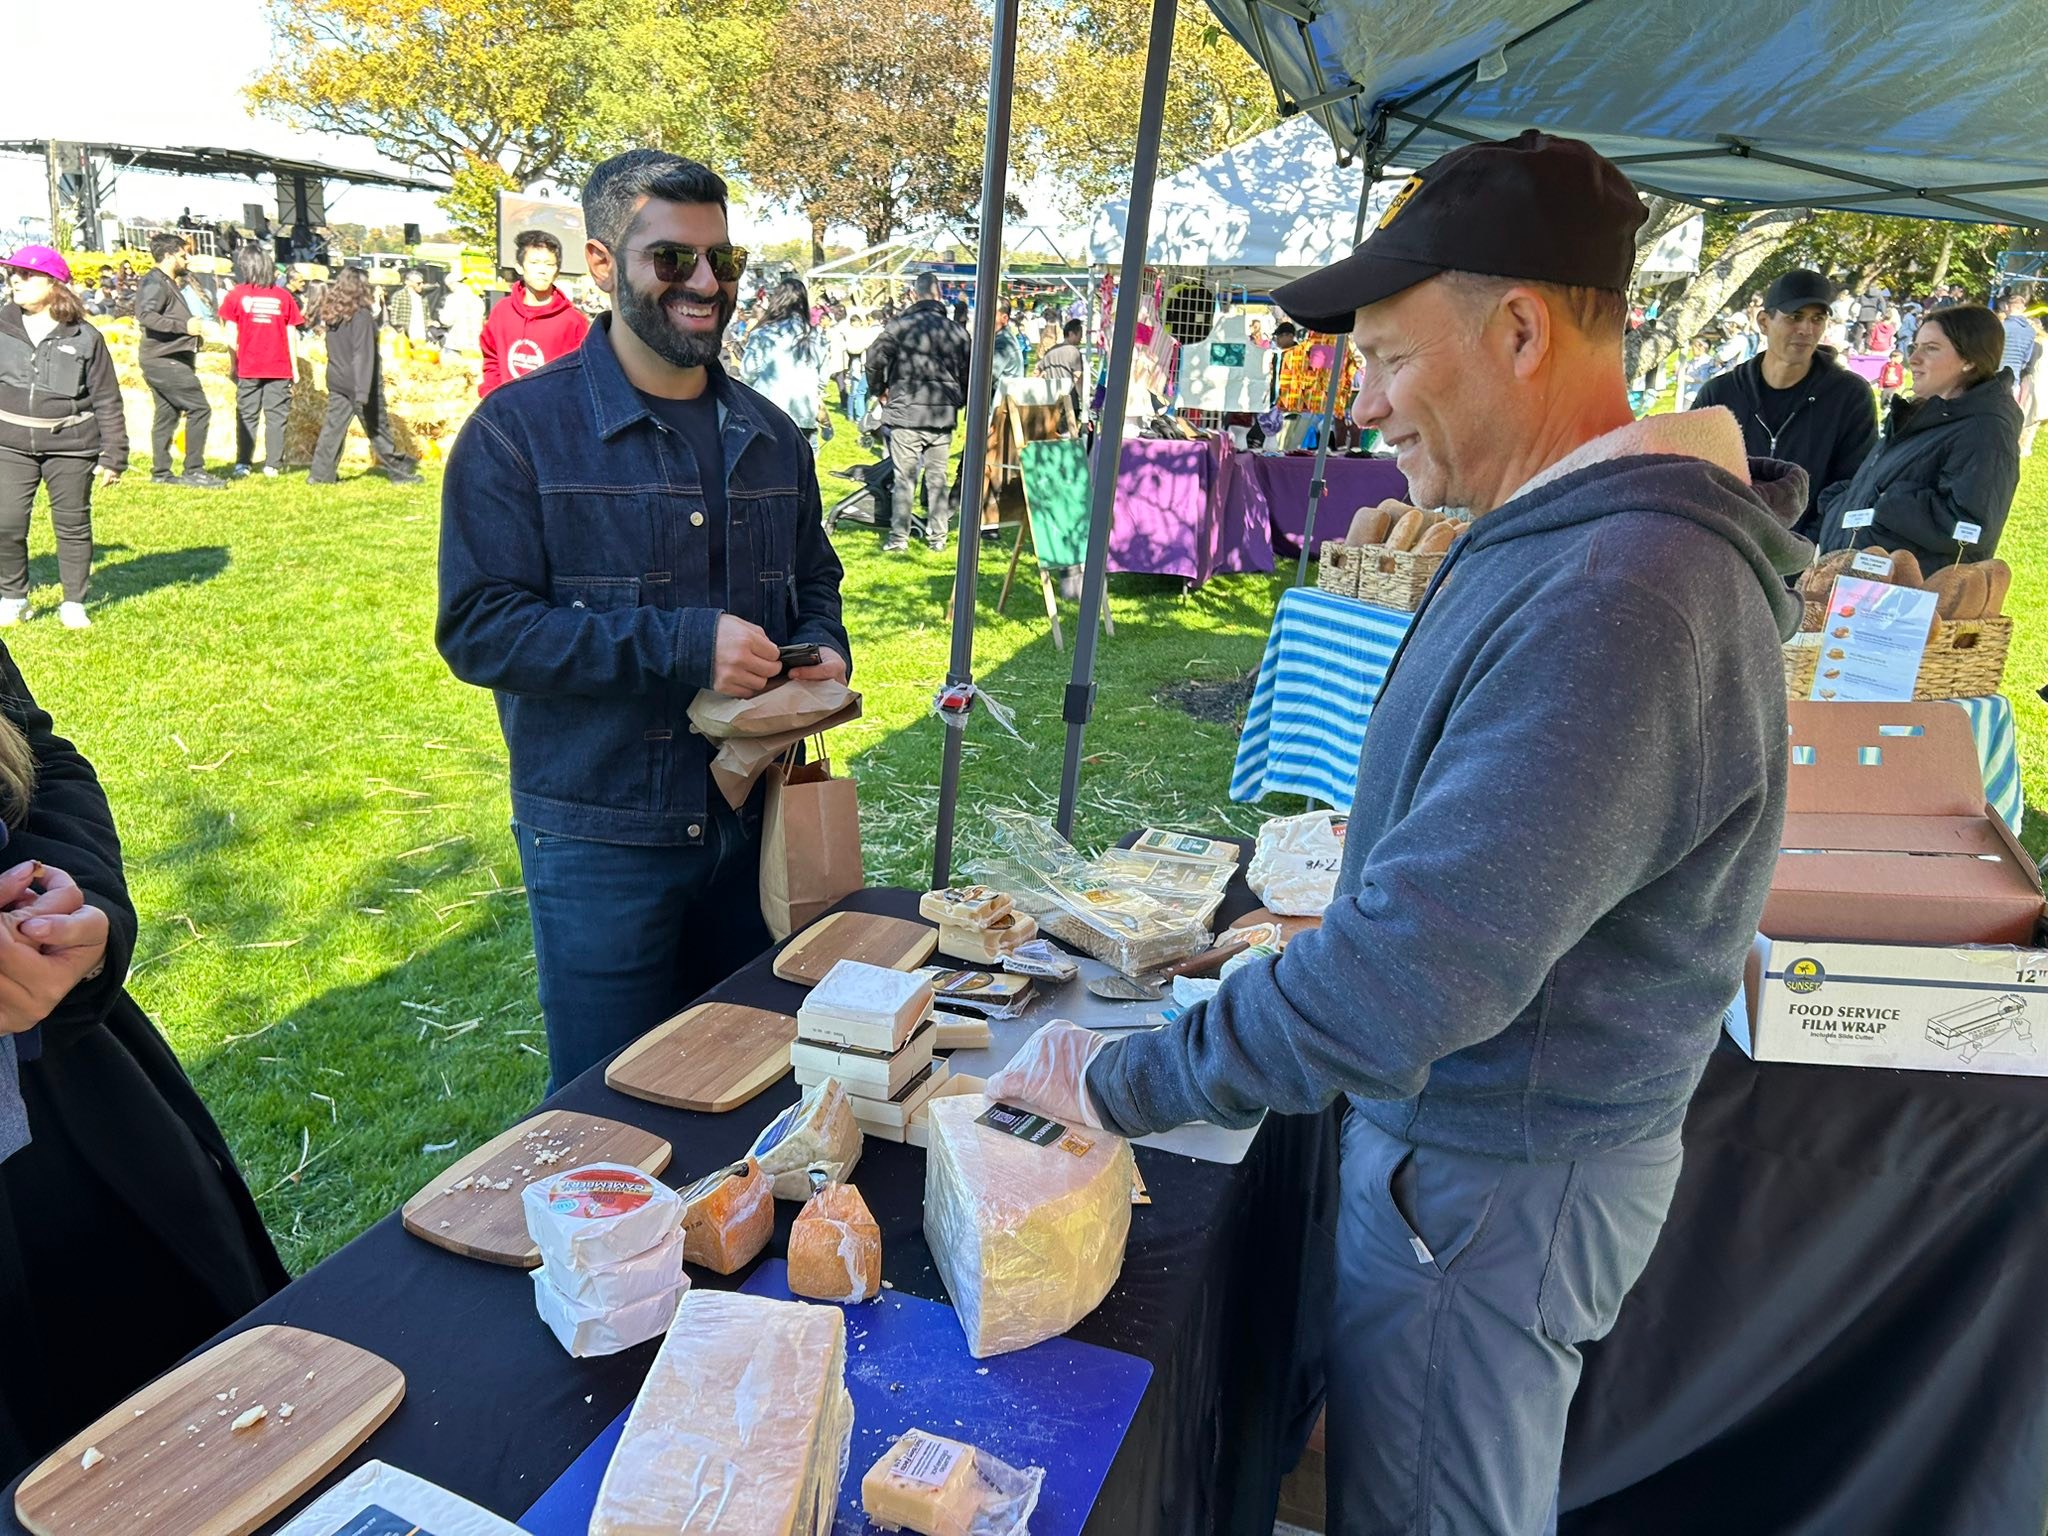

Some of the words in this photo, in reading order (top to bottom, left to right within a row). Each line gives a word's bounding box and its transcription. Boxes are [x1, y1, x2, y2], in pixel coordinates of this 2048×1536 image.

[1786, 980, 1820, 991] SUNSET
[1788, 1003, 1834, 1017] FOOD
[1838, 1006, 1901, 1021] SERVICE
[1802, 1018, 1836, 1031] FILM
[1842, 1020, 1887, 1034] WRAP
[1810, 1031, 1836, 1039] Includes
[564, 1181, 645, 1191] CAMEMBERT
